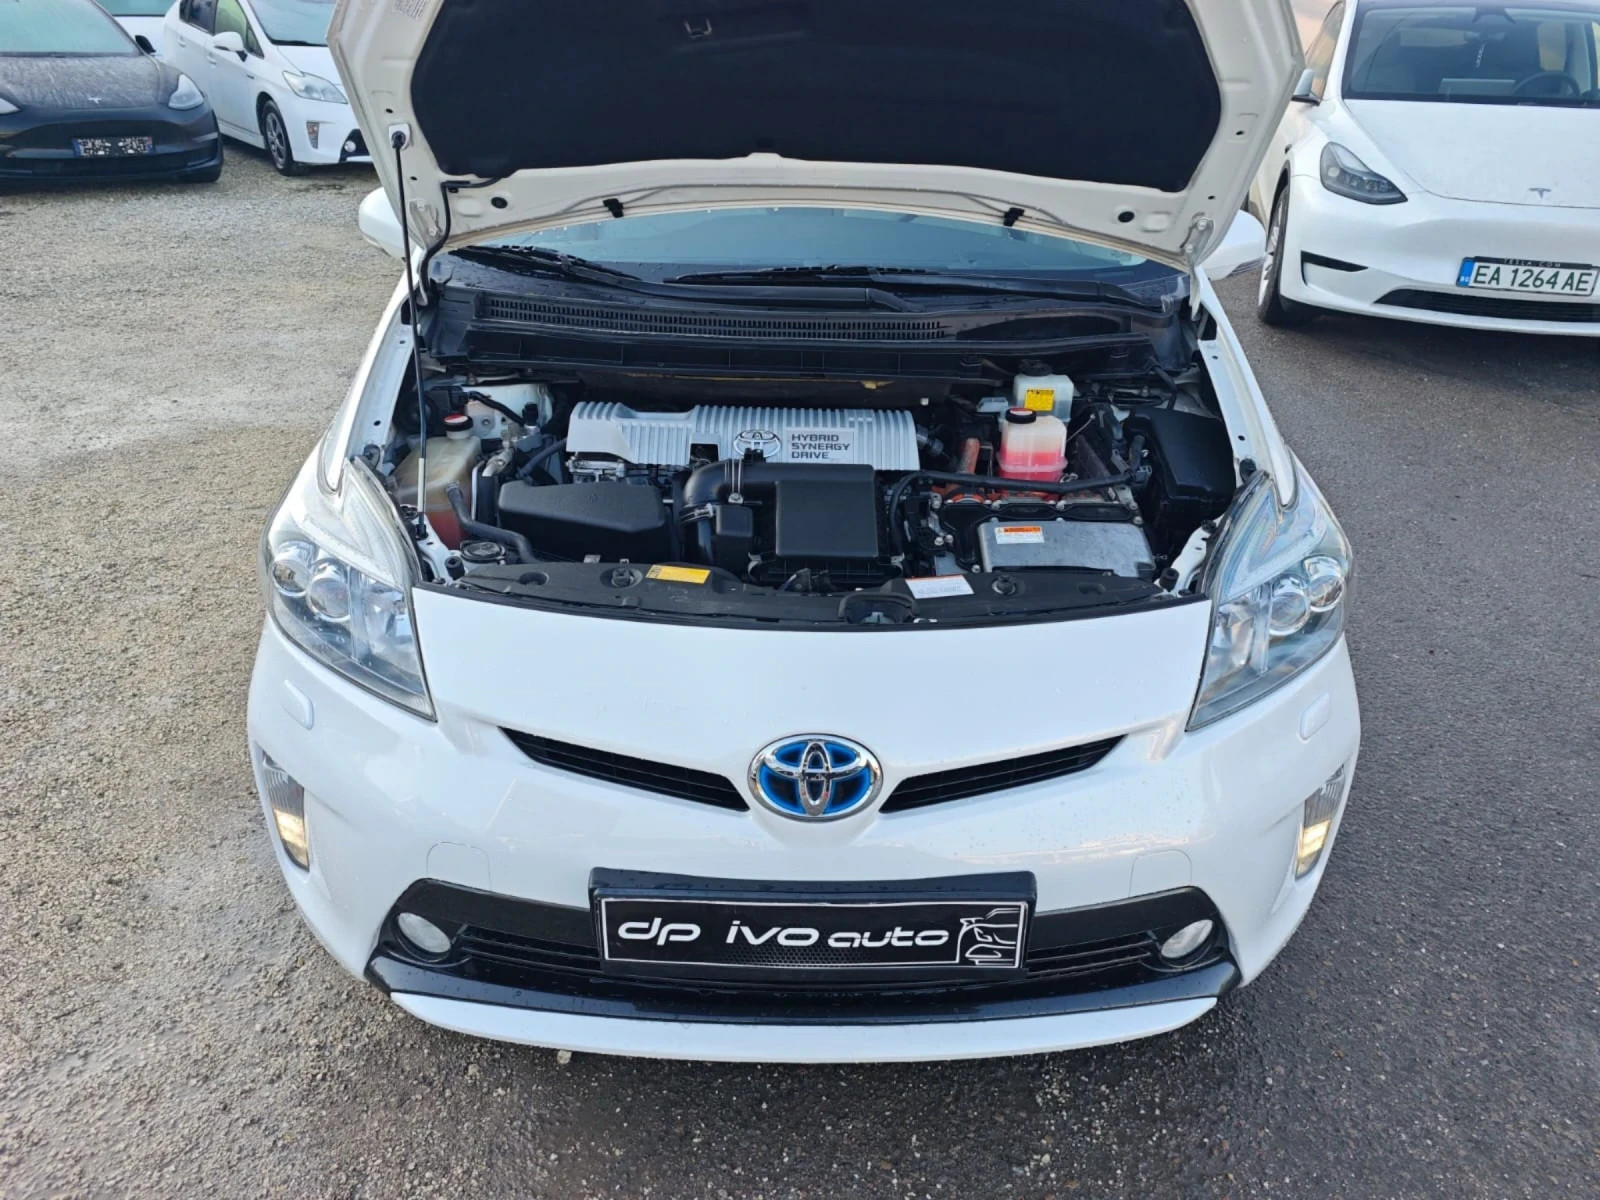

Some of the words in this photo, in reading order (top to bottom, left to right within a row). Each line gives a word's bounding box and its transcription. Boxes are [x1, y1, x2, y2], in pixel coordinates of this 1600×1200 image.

[1473, 265, 1500, 285] EA
[1510, 268, 1560, 289] 1264
[1561, 272, 1592, 292] AE
[791, 433, 839, 442] HYBRID
[791, 442, 850, 451] SYNERGY
[791, 451, 829, 459] DRIVE
[618, 917, 701, 946] dp
[726, 920, 820, 947] ivo
[827, 929, 949, 948] auto
